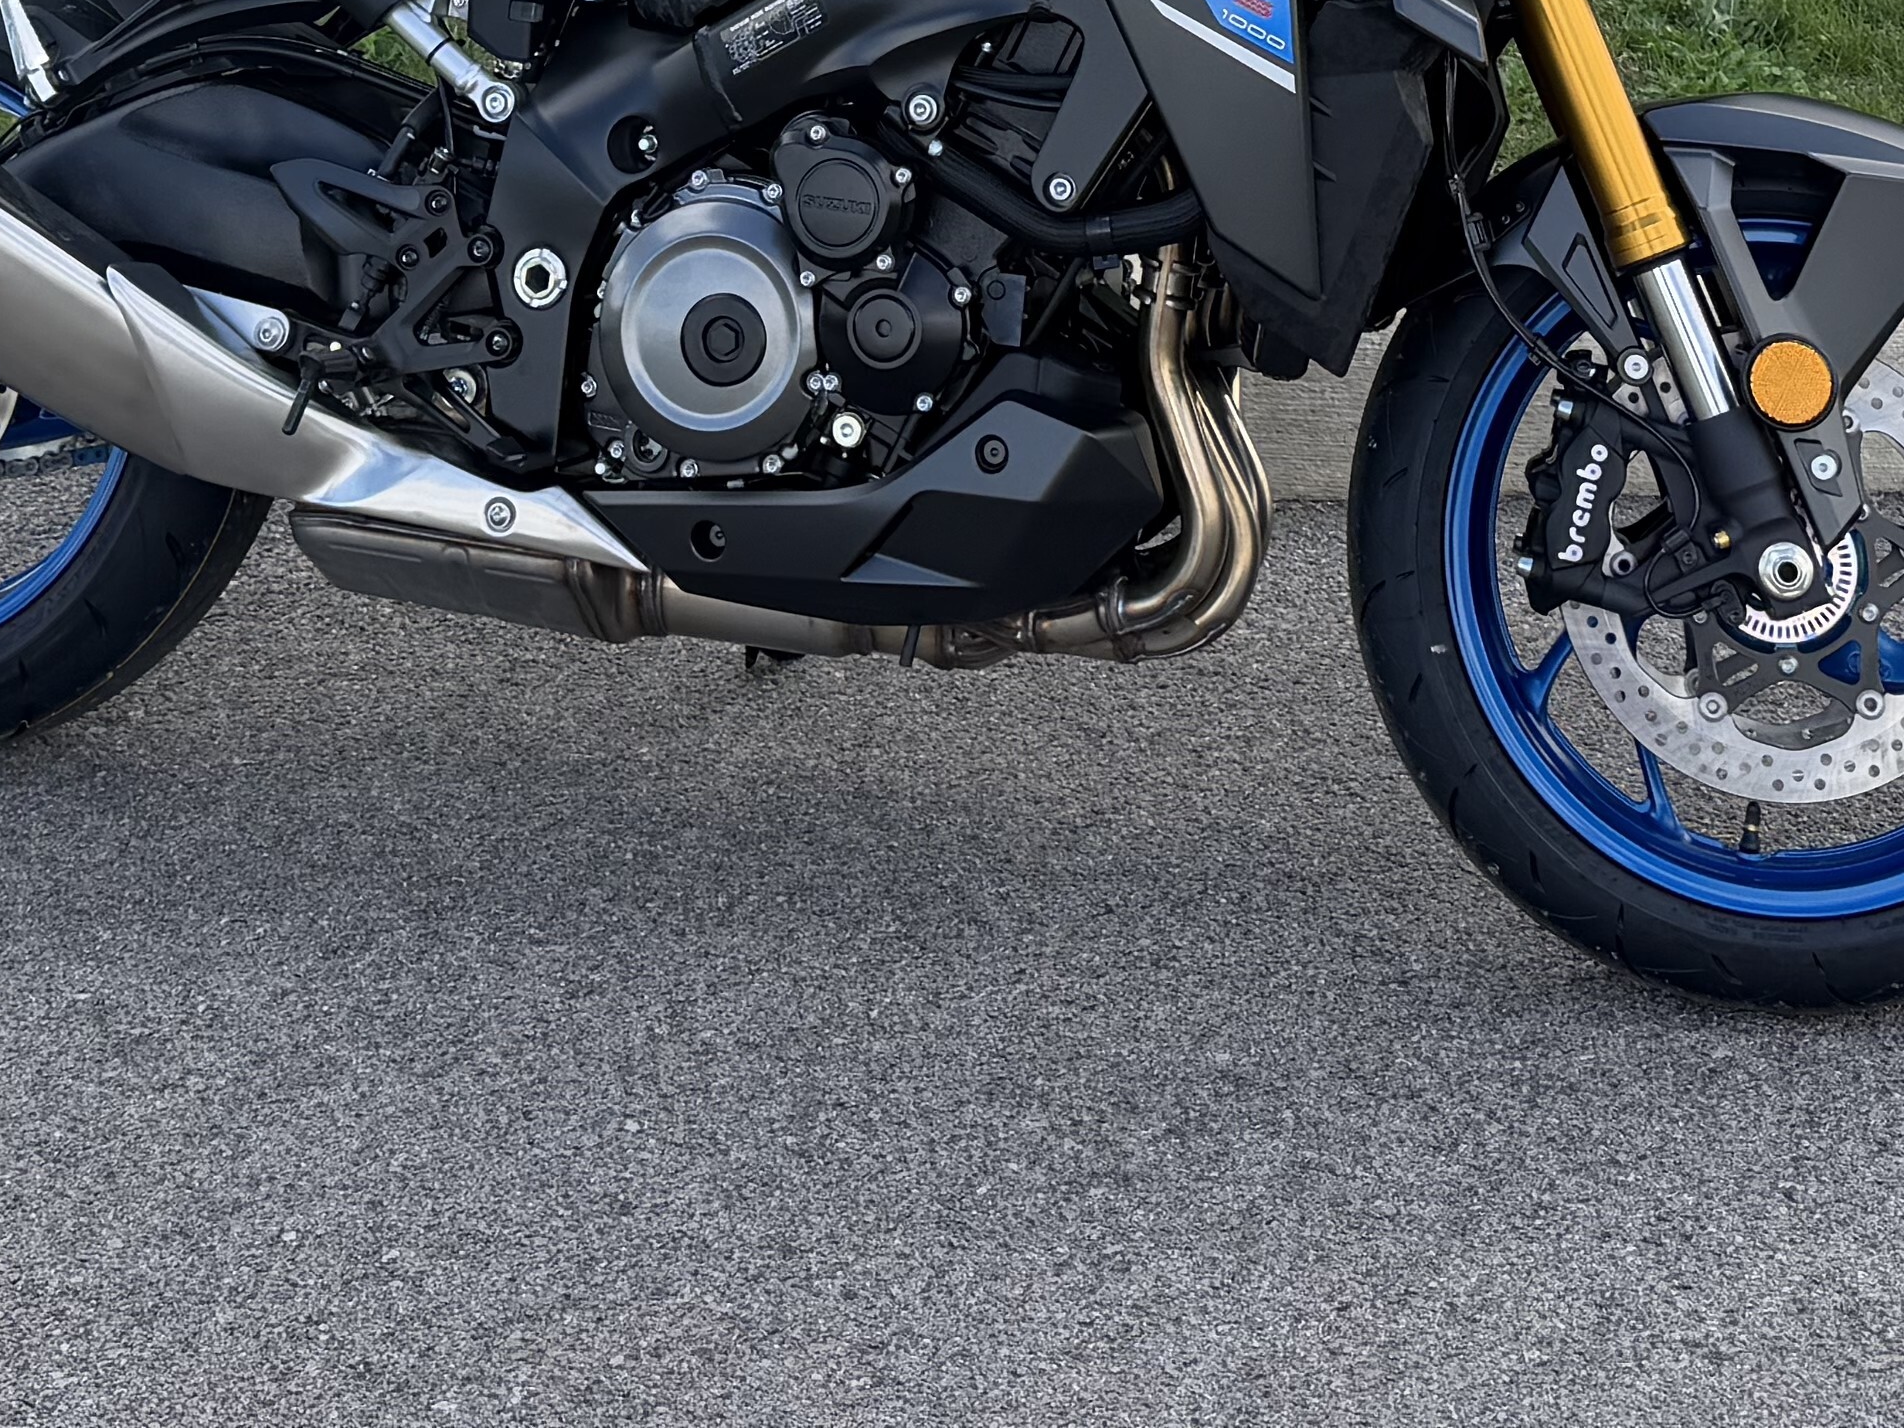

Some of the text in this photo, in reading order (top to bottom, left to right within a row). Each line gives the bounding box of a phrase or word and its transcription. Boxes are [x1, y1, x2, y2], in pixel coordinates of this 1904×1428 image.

[1222, 8, 1286, 51] 1000
[802, 194, 871, 215] SUZUKI
[1557, 444, 1608, 562] brembo
